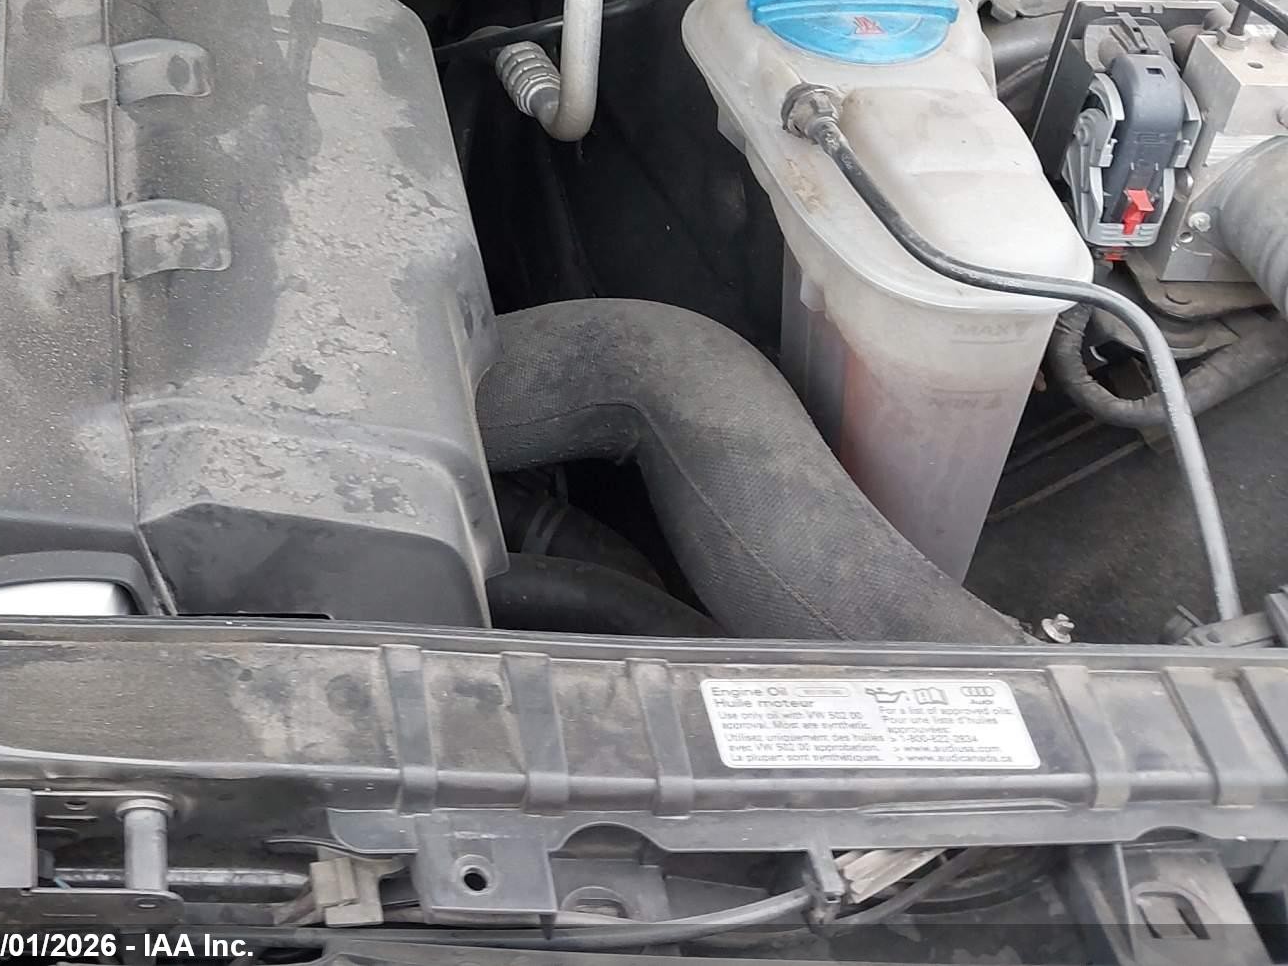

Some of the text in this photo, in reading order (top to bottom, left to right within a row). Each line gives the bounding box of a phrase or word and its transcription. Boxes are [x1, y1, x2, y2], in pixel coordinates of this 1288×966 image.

[711, 686, 788, 698] Engine Oil
[713, 698, 815, 708] Huile moteur
[741, 712, 763, 721] only
[767, 711, 780, 719] oil
[783, 711, 803, 720] with
[806, 711, 825, 719] VW
[828, 711, 848, 720] 502
[878, 706, 896, 715] For
[940, 706, 990, 716] approved
[771, 720, 800, 729] Most
[880, 715, 907, 724] Pour
[911, 716, 930, 724] une
[767, 733, 828, 743] uniquement
[832, 734, 850, 742] des
[728, 744, 753, 752] avec
[755, 742, 774, 751] VW
[776, 742, 796, 752] 502
[903, 745, 1001, 753] www.audiusa.com
[731, 753, 743, 762] La
[787, 754, 810, 762] sont
[906, 753, 1014, 763] www.audicanada.ca
